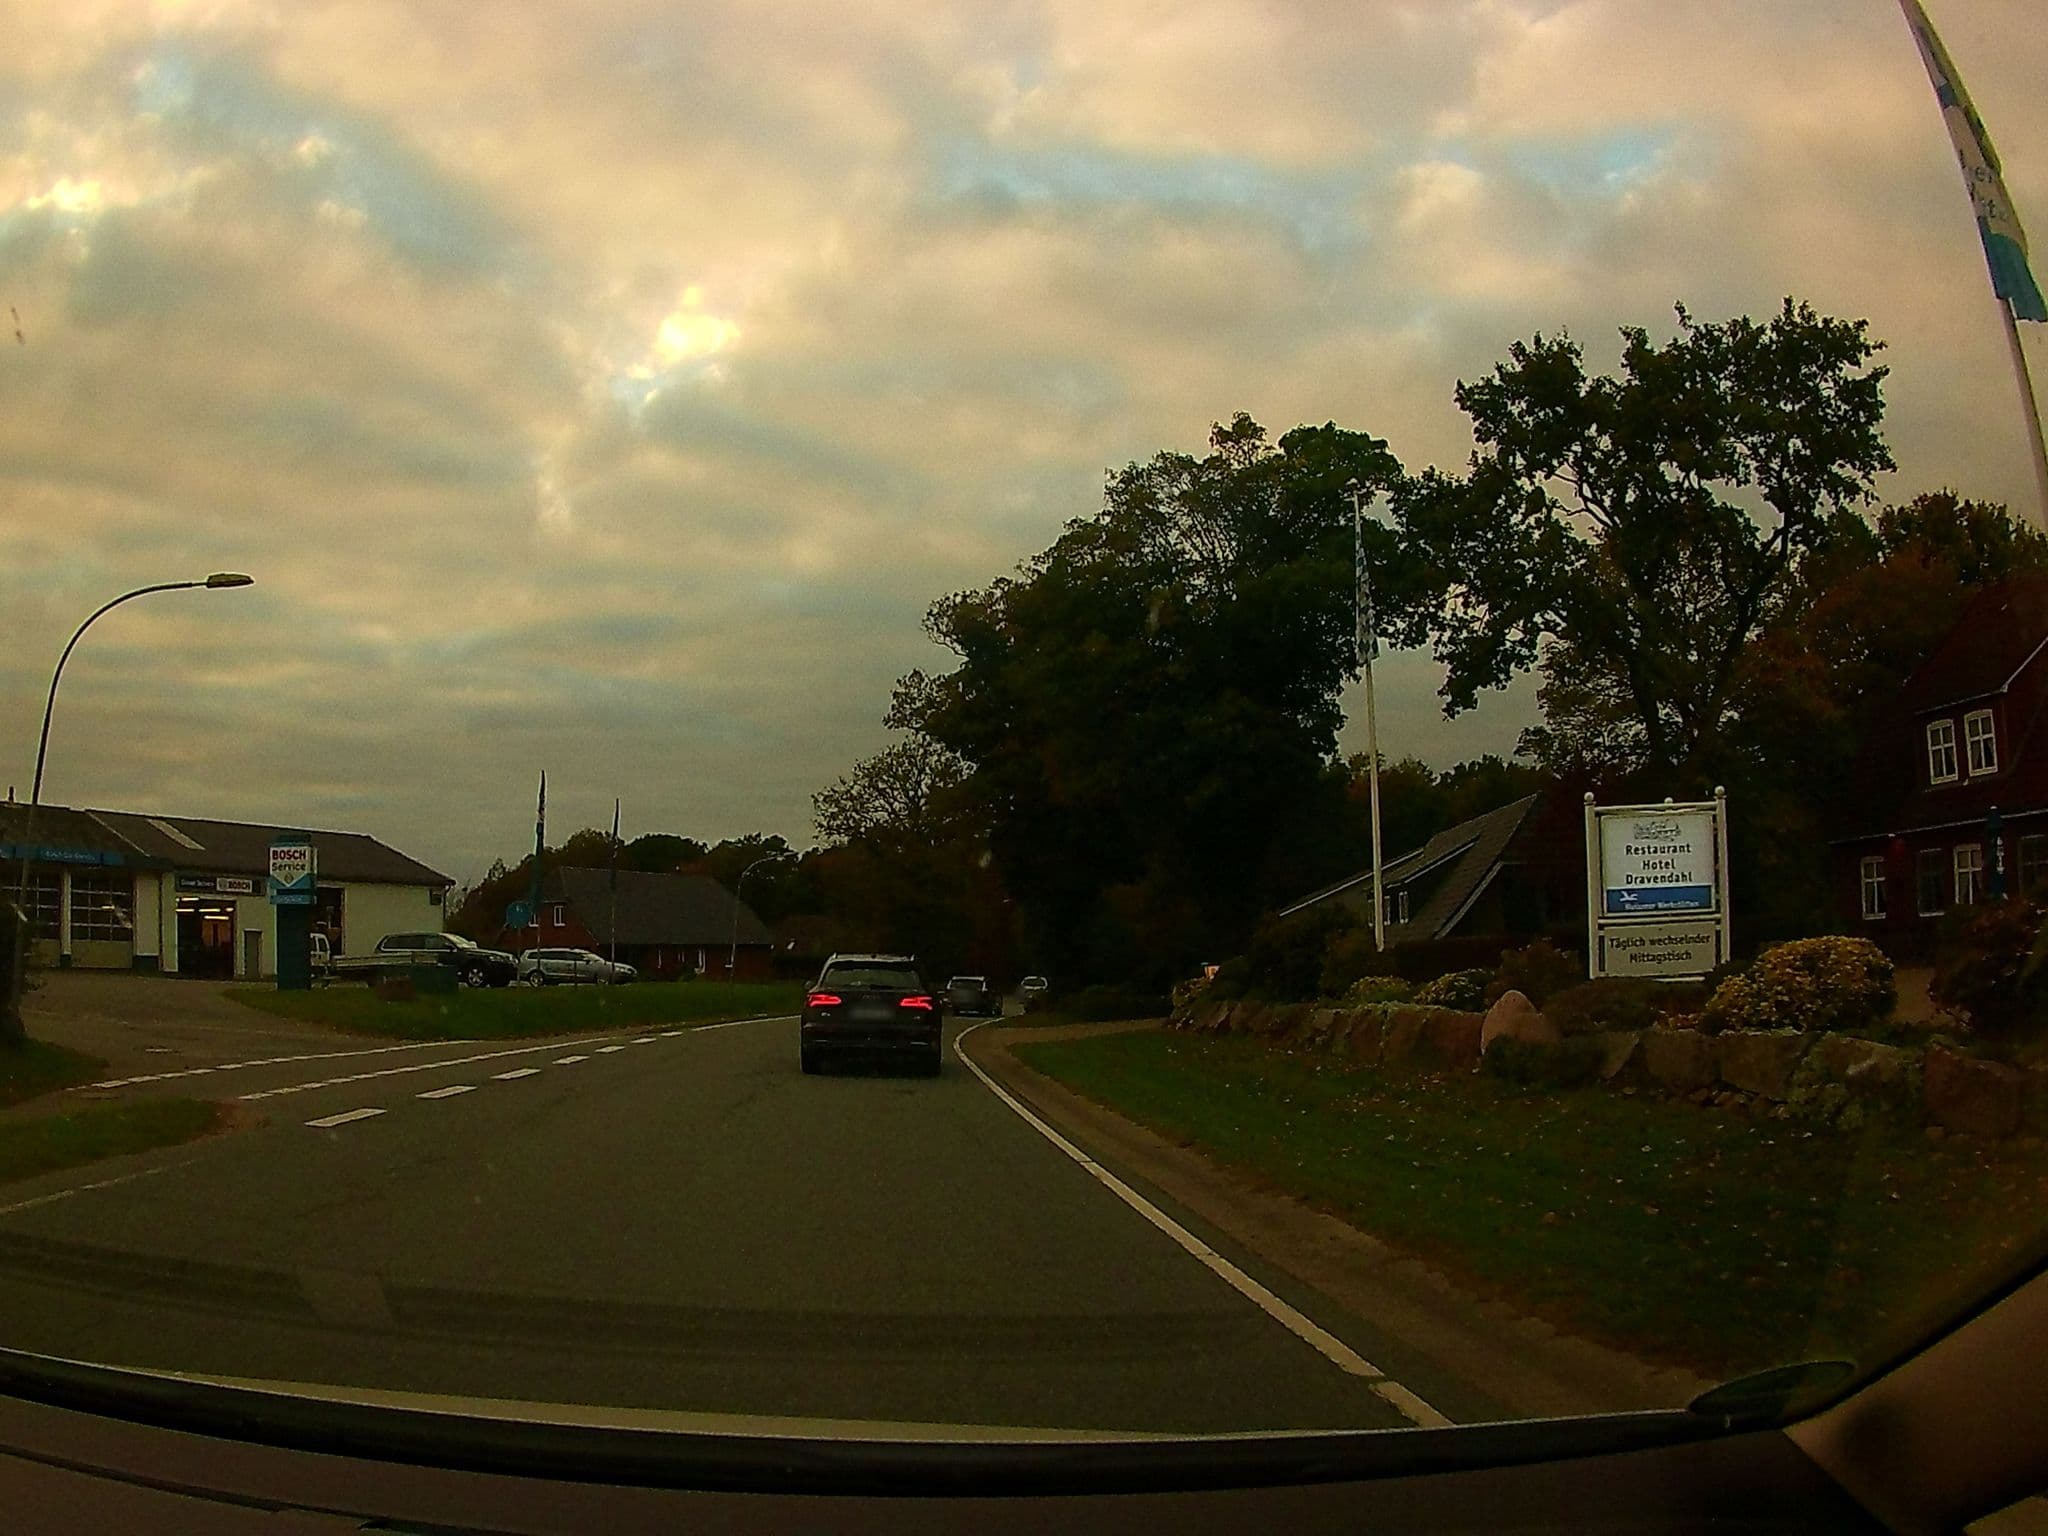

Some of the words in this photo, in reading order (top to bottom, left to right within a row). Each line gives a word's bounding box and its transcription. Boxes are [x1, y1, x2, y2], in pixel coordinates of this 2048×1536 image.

[272, 849, 306, 860] BOSCH
[1626, 843, 1691, 855] Restaurant
[272, 862, 306, 871] Service
[1643, 858, 1676, 870] Hotel
[1626, 872, 1693, 884] Dravendahl
[228, 880, 251, 889] BOSCH
[1609, 936, 1645, 950] Täglich
[1649, 933, 1711, 946] wechselnder
[1630, 950, 1692, 964] Mittagstisch
